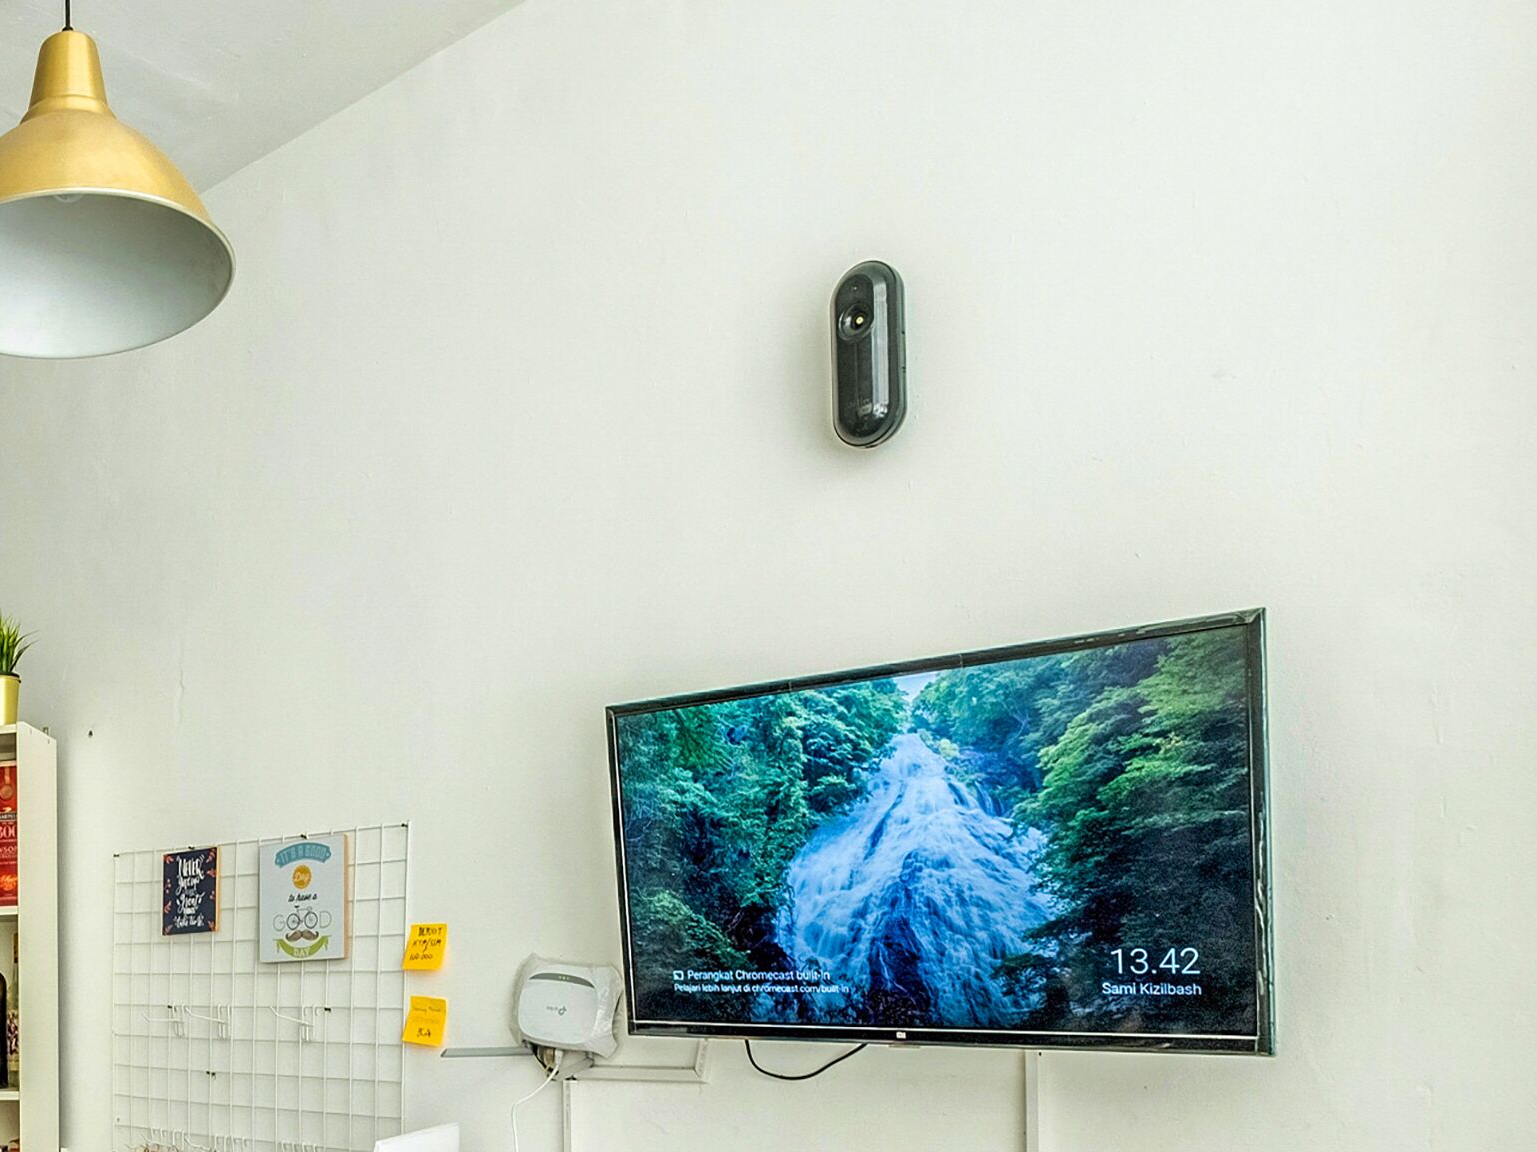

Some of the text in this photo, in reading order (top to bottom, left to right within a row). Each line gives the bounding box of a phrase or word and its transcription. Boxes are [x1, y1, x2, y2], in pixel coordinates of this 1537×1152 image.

[1111, 947, 1201, 975] 13.42
[687, 969, 734, 982] Perangkat
[735, 969, 794, 981] Chromecast
[1102, 982, 1202, 996] Sami Kizilbash
